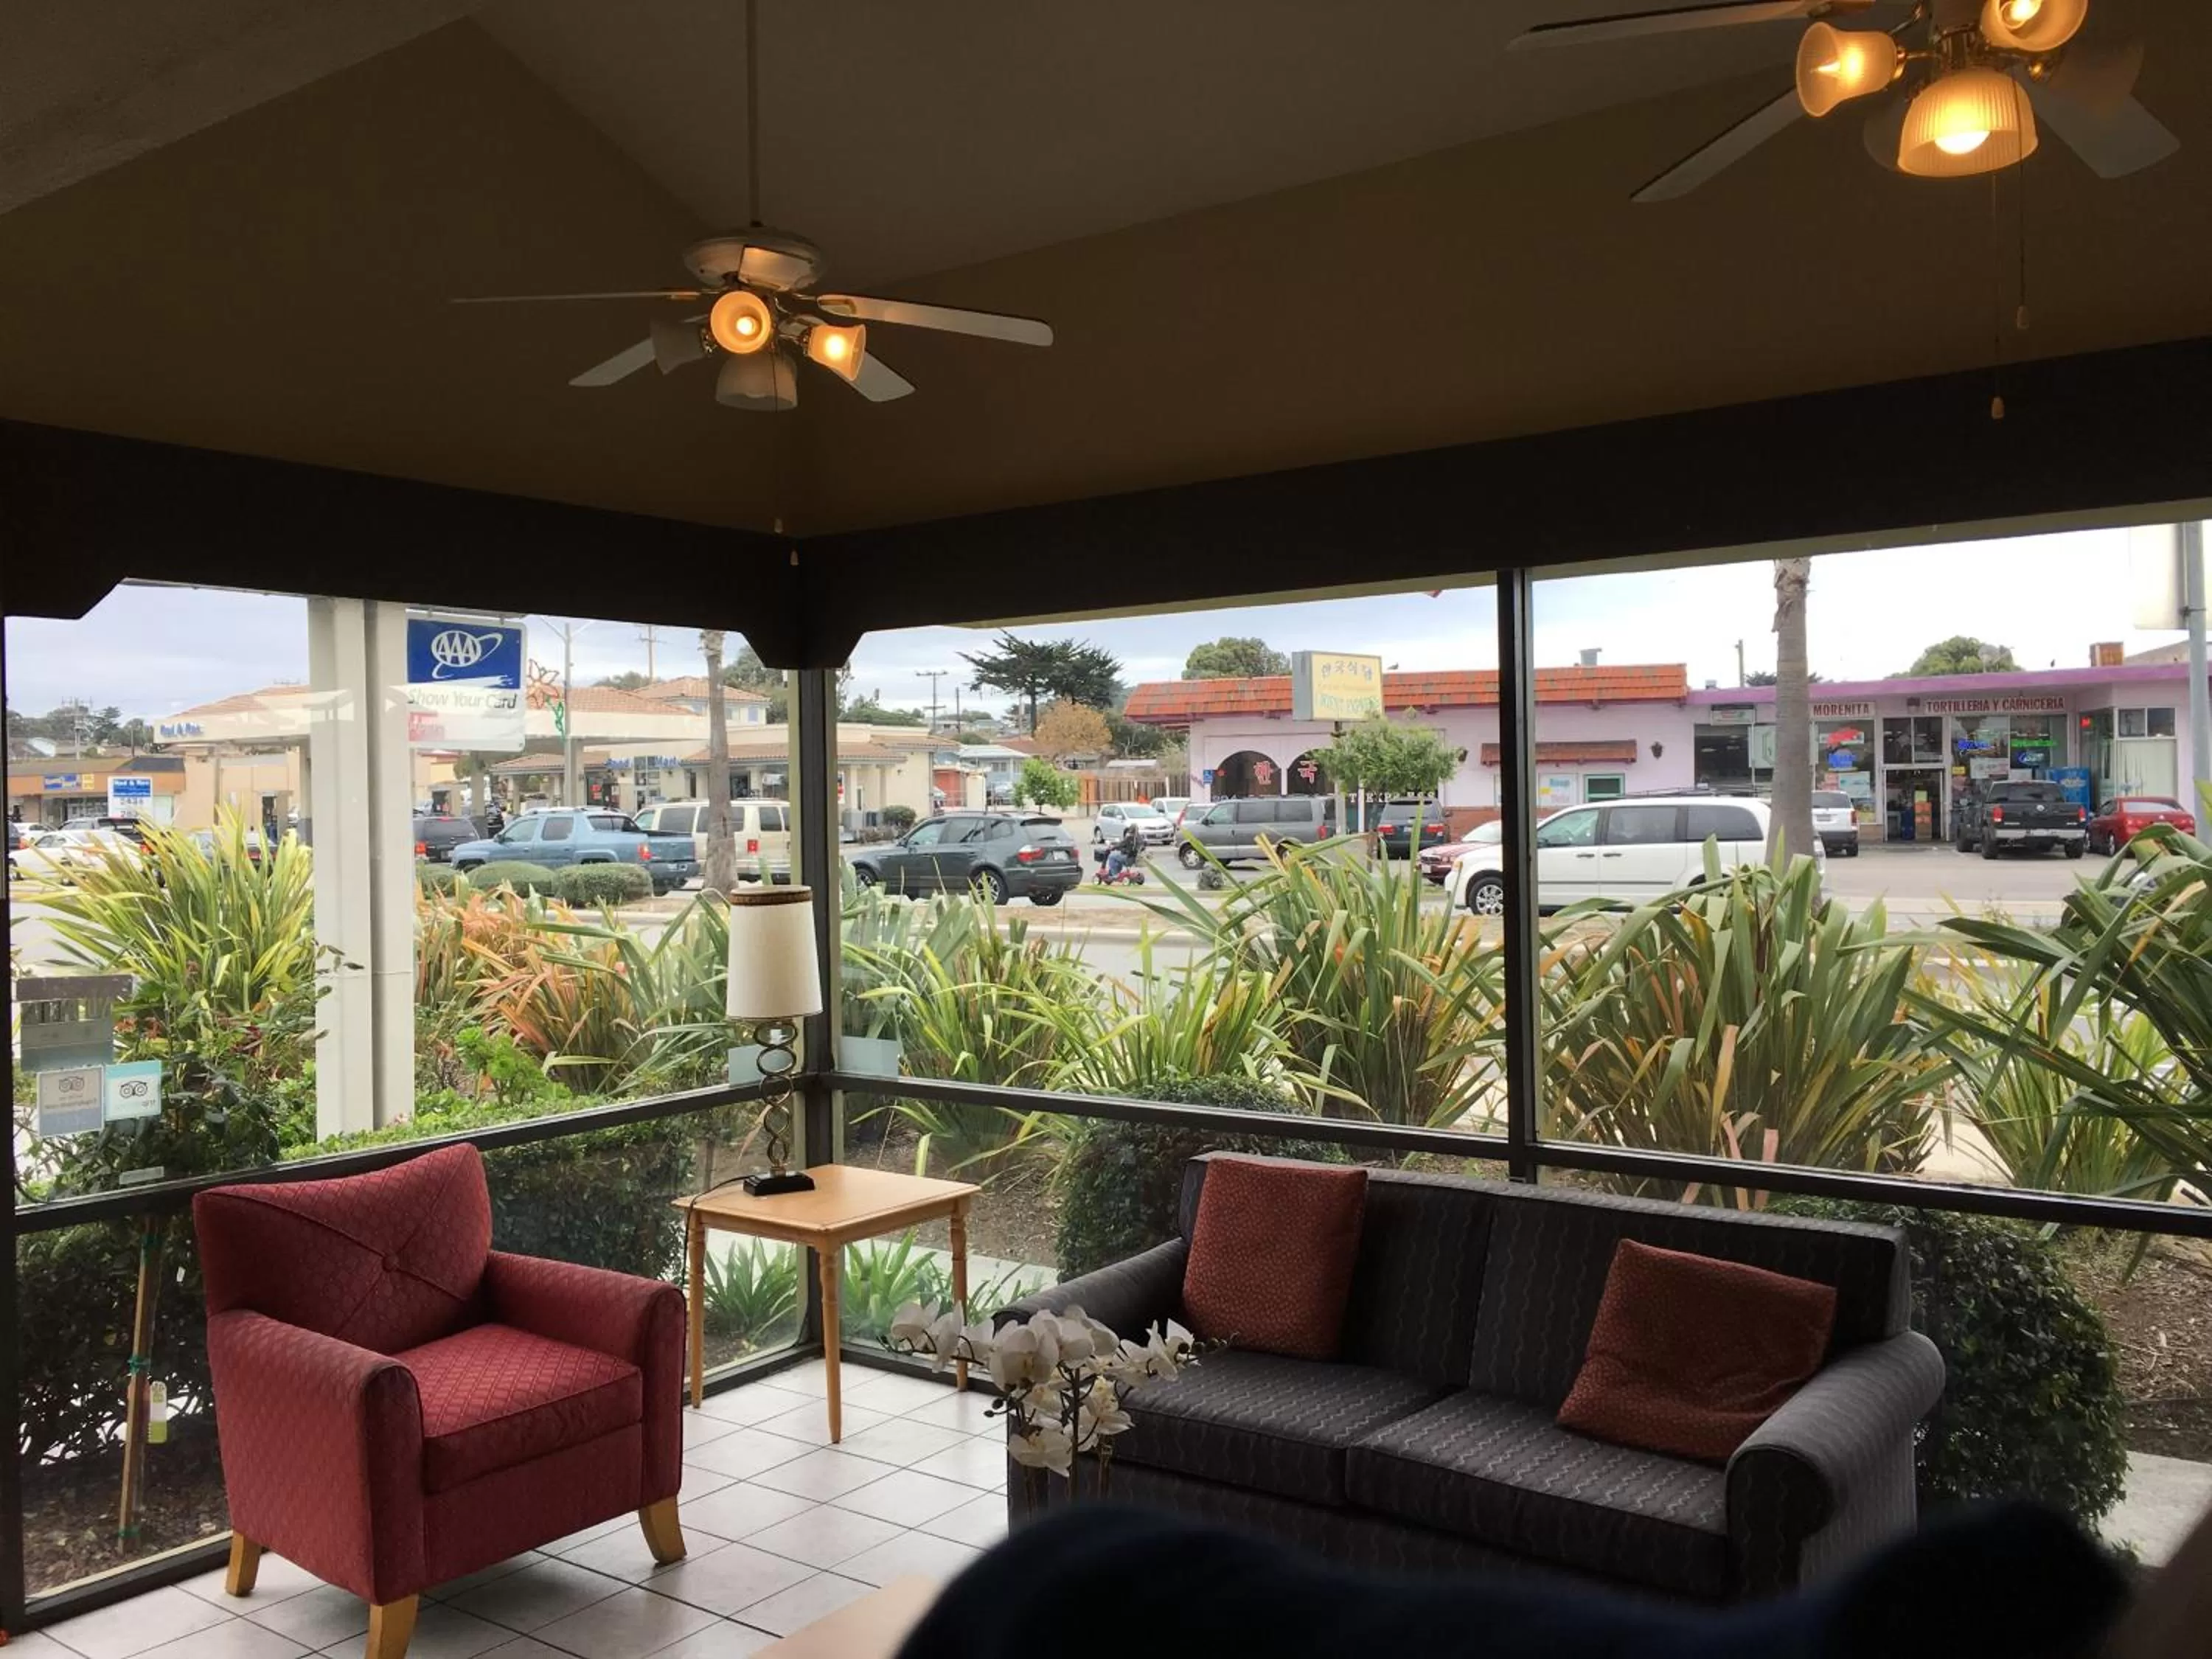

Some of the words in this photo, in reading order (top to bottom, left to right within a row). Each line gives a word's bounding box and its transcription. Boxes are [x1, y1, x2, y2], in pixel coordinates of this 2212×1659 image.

[437, 632, 477, 666] AAA
[407, 687, 449, 706] Show
[453, 690, 484, 707] Your
[486, 692, 518, 709] Card
[1927, 700, 1990, 713] TORTILLERIA
[1993, 700, 2000, 711] Y
[2002, 697, 2065, 710] CARNICERIA
[1813, 703, 1870, 716] MORENITA
